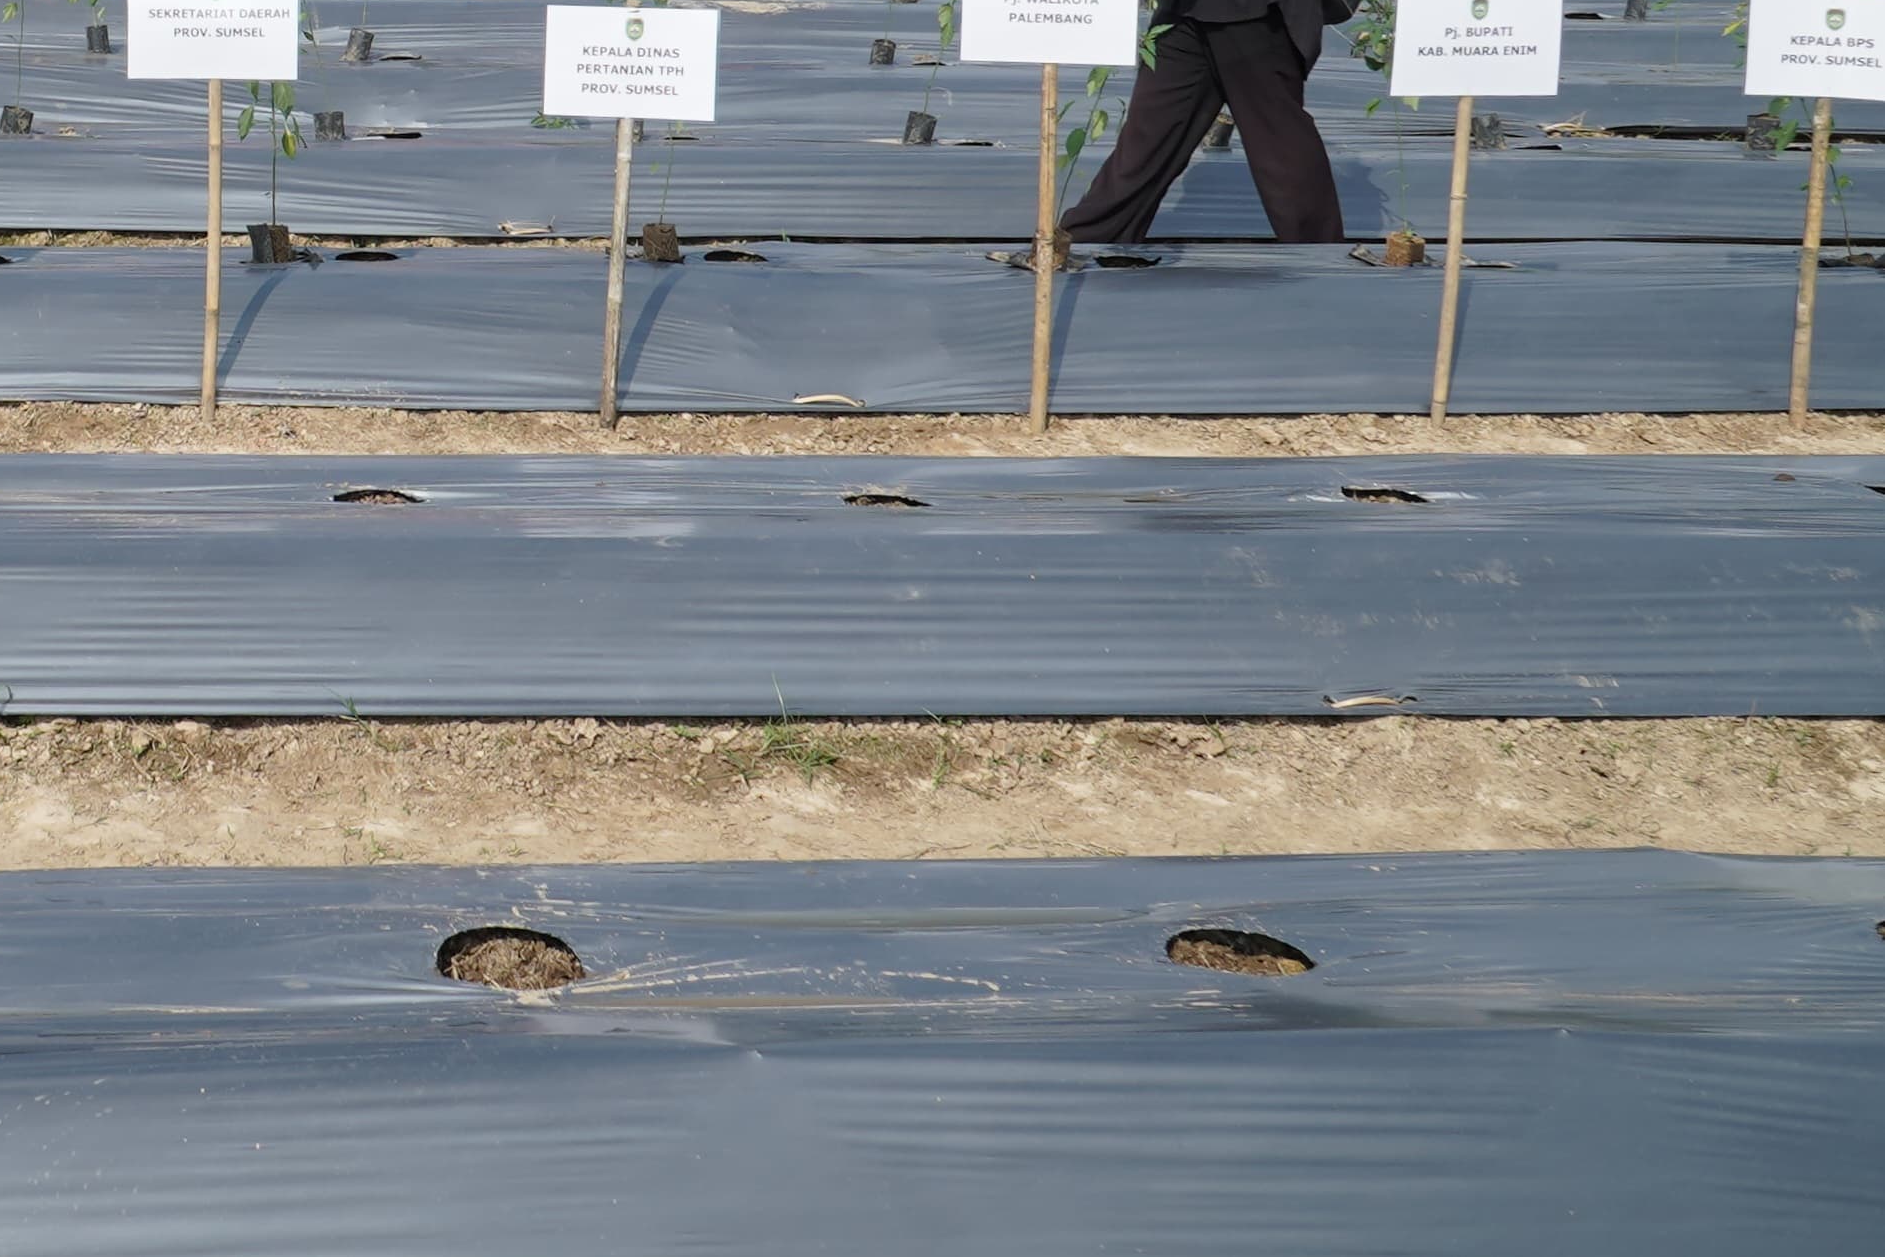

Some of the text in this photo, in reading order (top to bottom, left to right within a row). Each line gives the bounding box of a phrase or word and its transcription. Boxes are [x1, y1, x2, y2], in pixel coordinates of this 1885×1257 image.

[147, 7, 291, 20] SEKRETARIAT DAERAH
[1008, 11, 1094, 26] PALEMBANG
[173, 27, 266, 39] PROV. SUMSEL
[1444, 25, 1514, 40] Pj. BUPATI
[1789, 35, 1876, 49] KEPALA BPS
[582, 45, 681, 59] KEPALA DINAS
[1417, 43, 1538, 58] KAB. MUARA ENIM
[1780, 53, 1883, 68] PROV. SUMSEL
[576, 63, 685, 77] PERTANIAN TPH
[580, 83, 679, 97] PROV. SUMSEL
